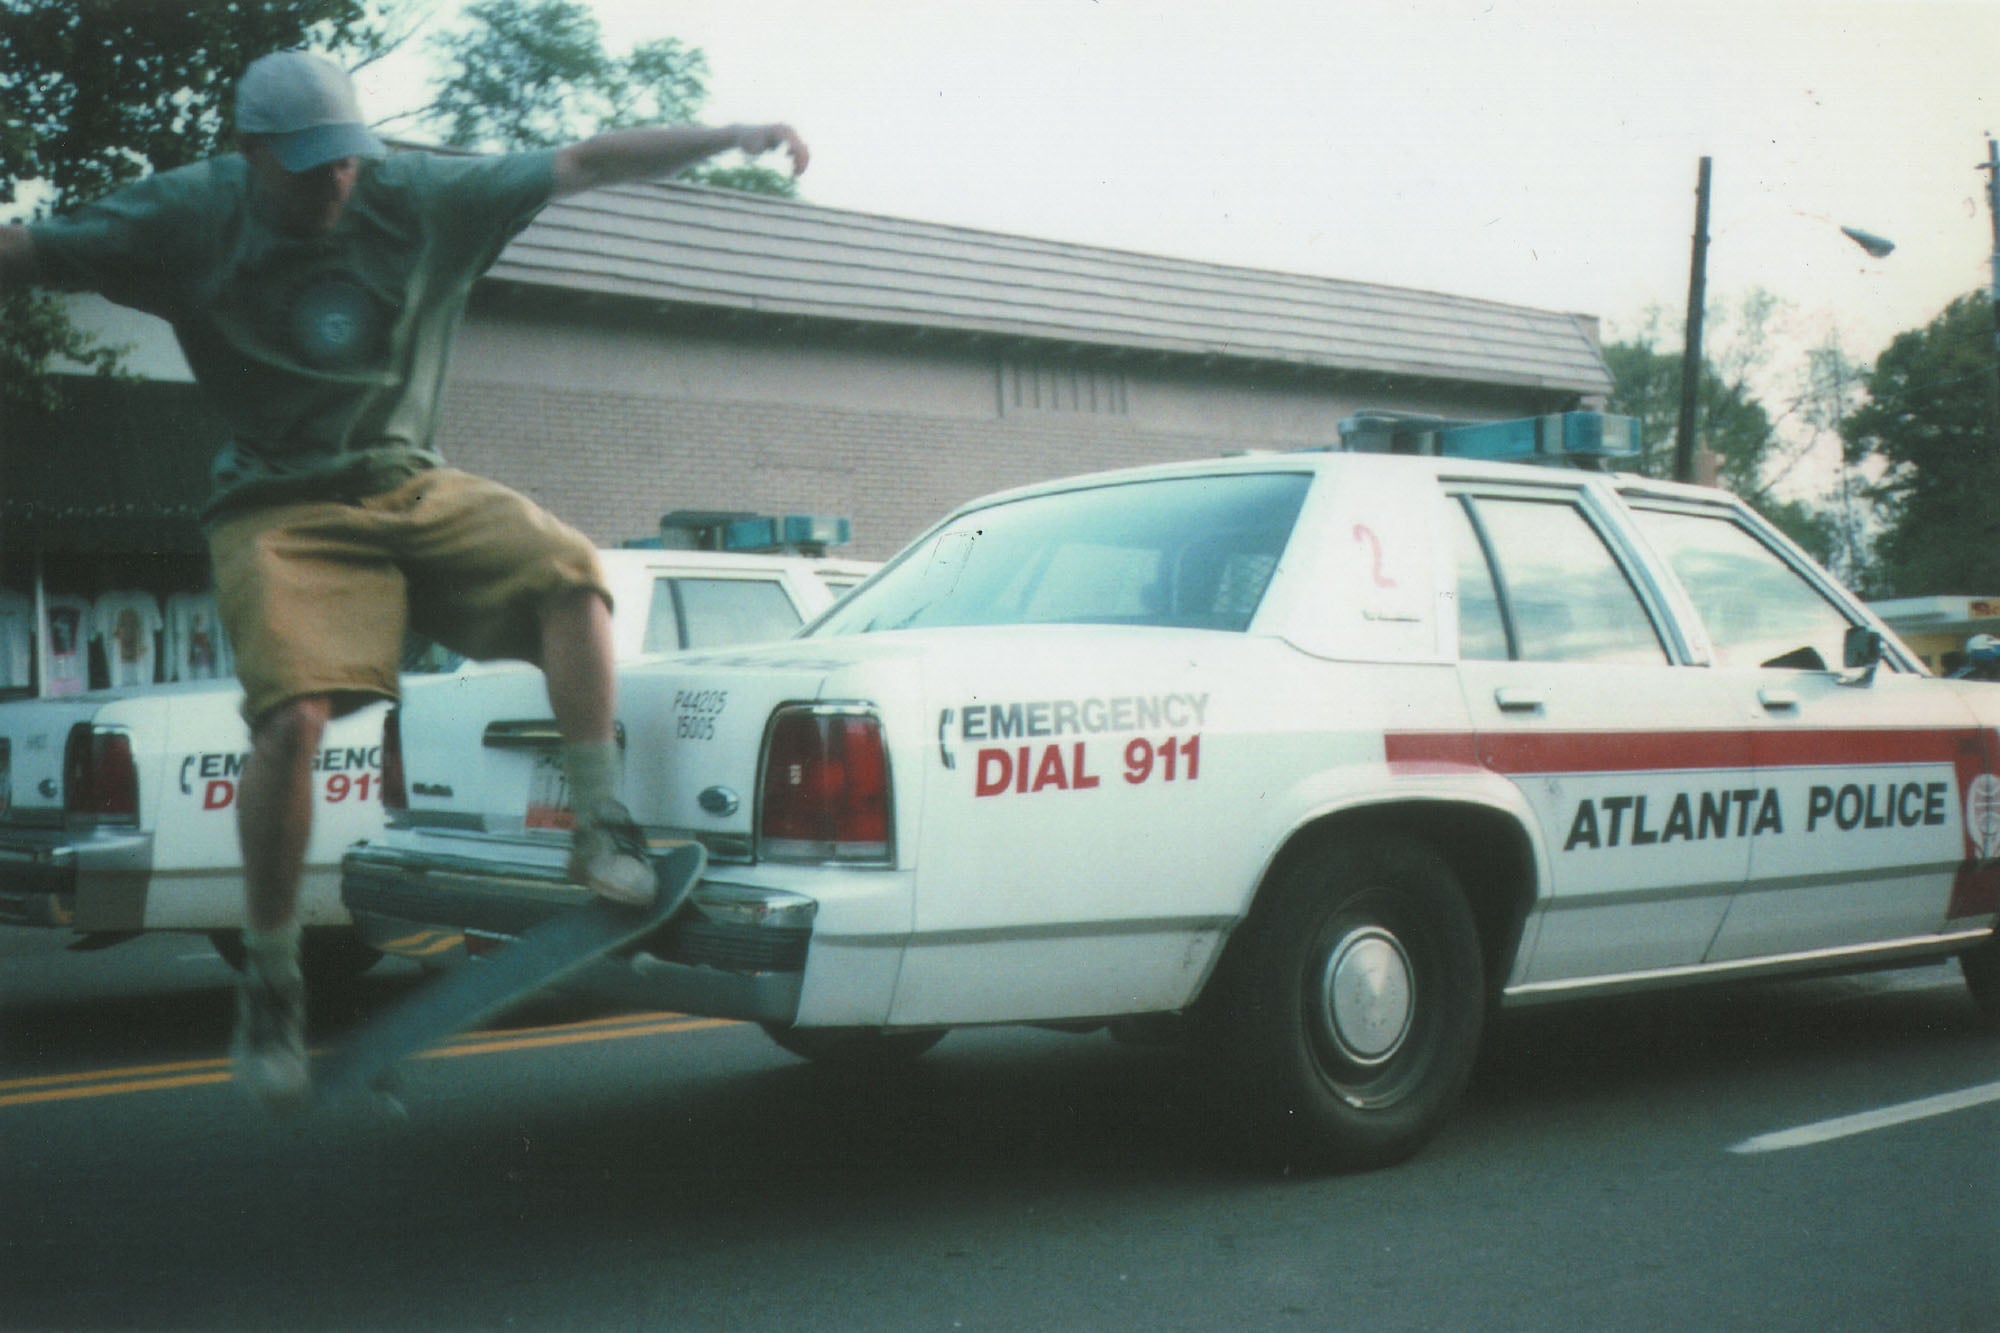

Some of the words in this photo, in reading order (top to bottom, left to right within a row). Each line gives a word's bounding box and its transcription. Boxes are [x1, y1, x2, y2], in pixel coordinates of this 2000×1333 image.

[962, 693, 1210, 742] EMERGENCY
[975, 742, 1100, 797] DIAL
[1123, 734, 1200, 784] 911
[1563, 787, 1784, 851] ATLANTA
[1806, 782, 1948, 832] POLICE
